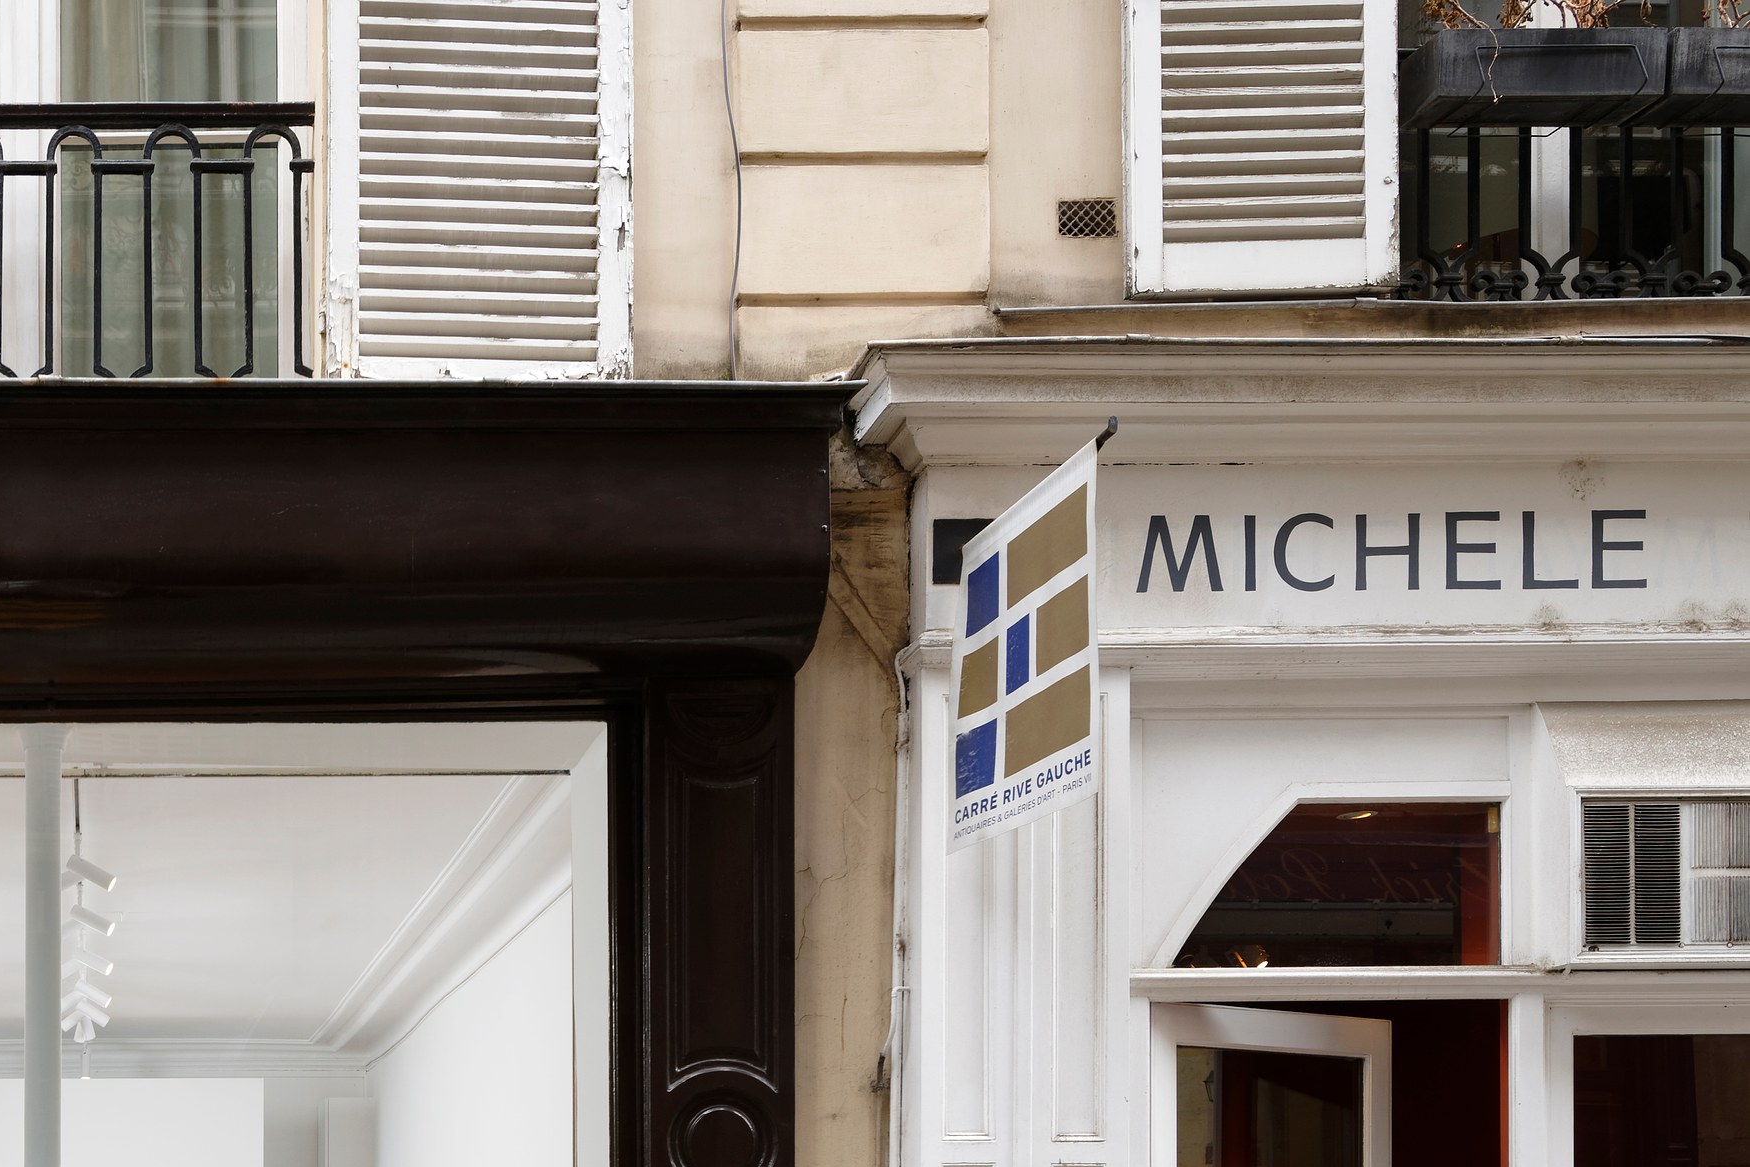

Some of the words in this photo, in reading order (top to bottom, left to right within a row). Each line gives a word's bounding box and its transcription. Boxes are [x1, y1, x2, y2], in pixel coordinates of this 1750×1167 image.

[1136, 509, 1648, 593] MICHELE
[953, 815, 996, 841] ANTIQUAIRES
[997, 813, 1003, 822] &
[1003, 799, 1036, 820] GALERIES
[1037, 789, 1056, 806] D'ART
[1062, 779, 1083, 794] PARIS
[954, 790, 998, 825] CARRÉ
[1002, 778, 1032, 805] RIVE
[1036, 748, 1092, 788] GAUCHE
